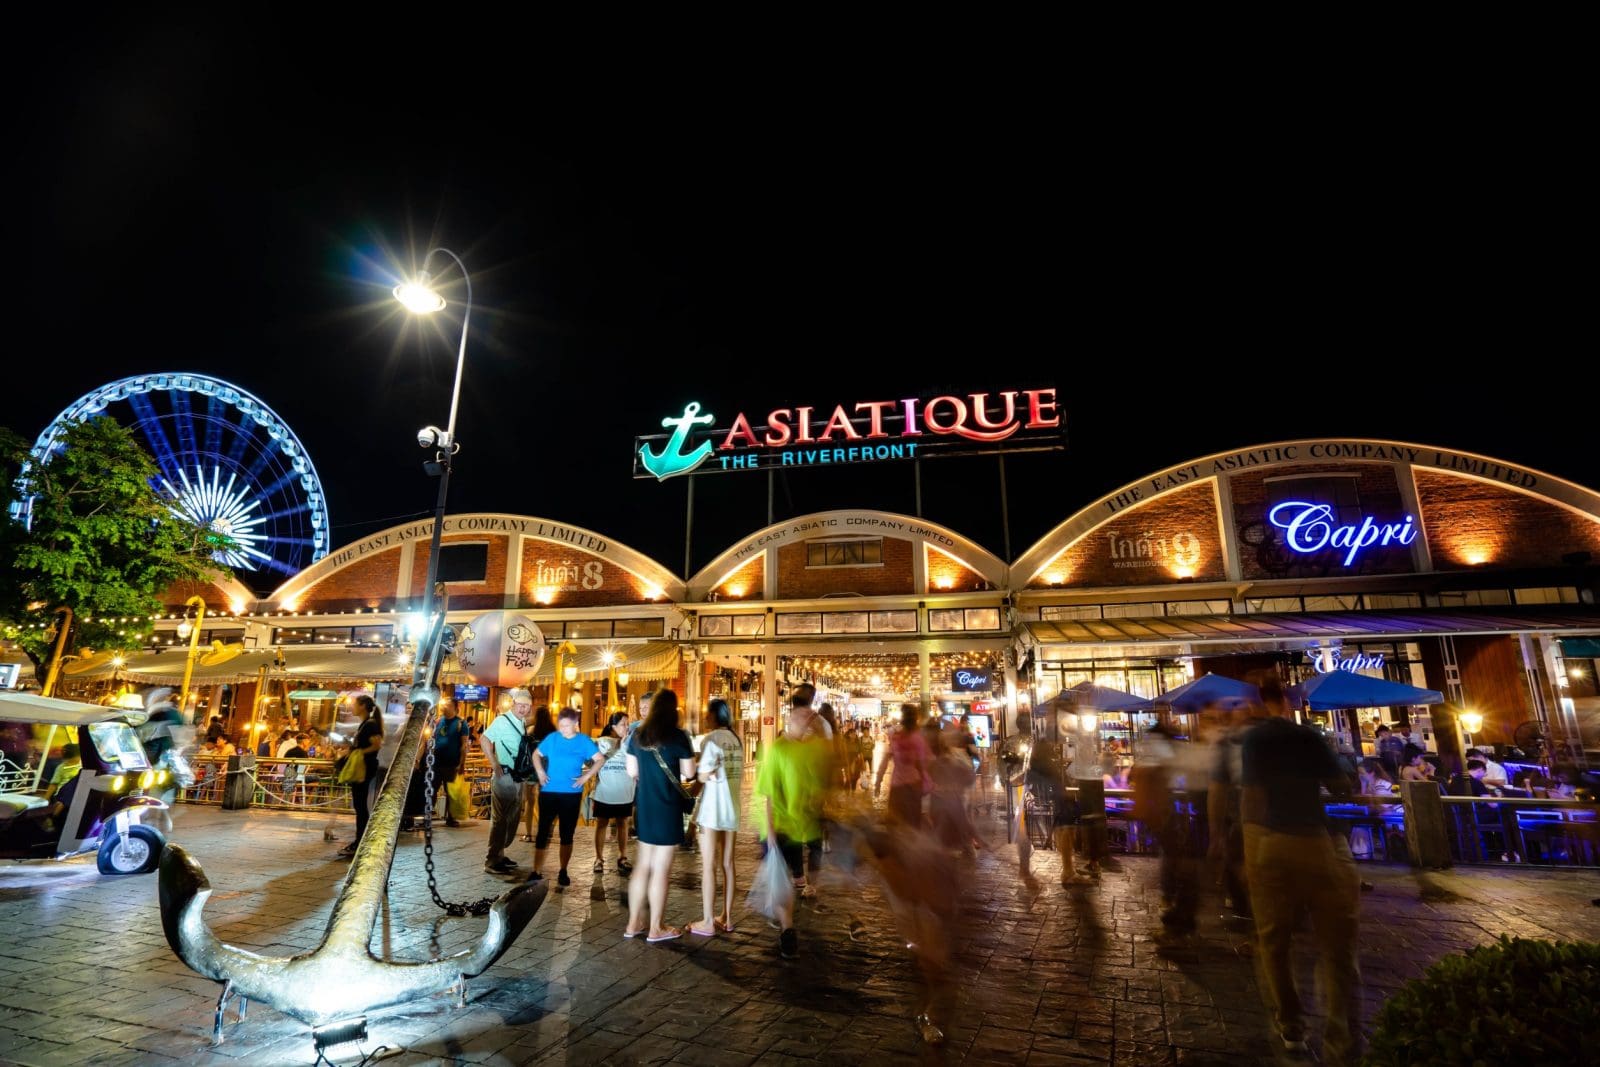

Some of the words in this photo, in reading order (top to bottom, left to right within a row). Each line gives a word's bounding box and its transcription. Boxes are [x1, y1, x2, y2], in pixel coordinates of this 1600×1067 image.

[718, 388, 1060, 450] ASIATIQUE
[719, 454, 759, 470] THE
[782, 443, 918, 466] RIVERFRONT
[1103, 487, 1145, 513] THE
[1151, 464, 1200, 492] EAST
[1213, 445, 1298, 473] ASIATIC
[1309, 443, 1420, 463] COMPANY
[1434, 452, 1538, 489] LIMITED
[332, 549, 355, 567] THE
[358, 534, 391, 554] EAST
[396, 520, 453, 542] ASIATC
[458, 518, 529, 532] COMPANY
[538, 523, 607, 553] LIMITED
[734, 543, 755, 559] THE
[758, 529, 787, 546] EAST
[792, 519, 838, 534] ASIATIC
[846, 517, 905, 531] COMPANY
[908, 525, 954, 547] LIMITED
[1172, 532, 1201, 566] 9
[1269, 501, 1418, 567] Capri
[581, 560, 604, 590] 8
[506, 655, 534, 670] Fish
[507, 644, 538, 658] Happy
[956, 671, 987, 688] Capri
